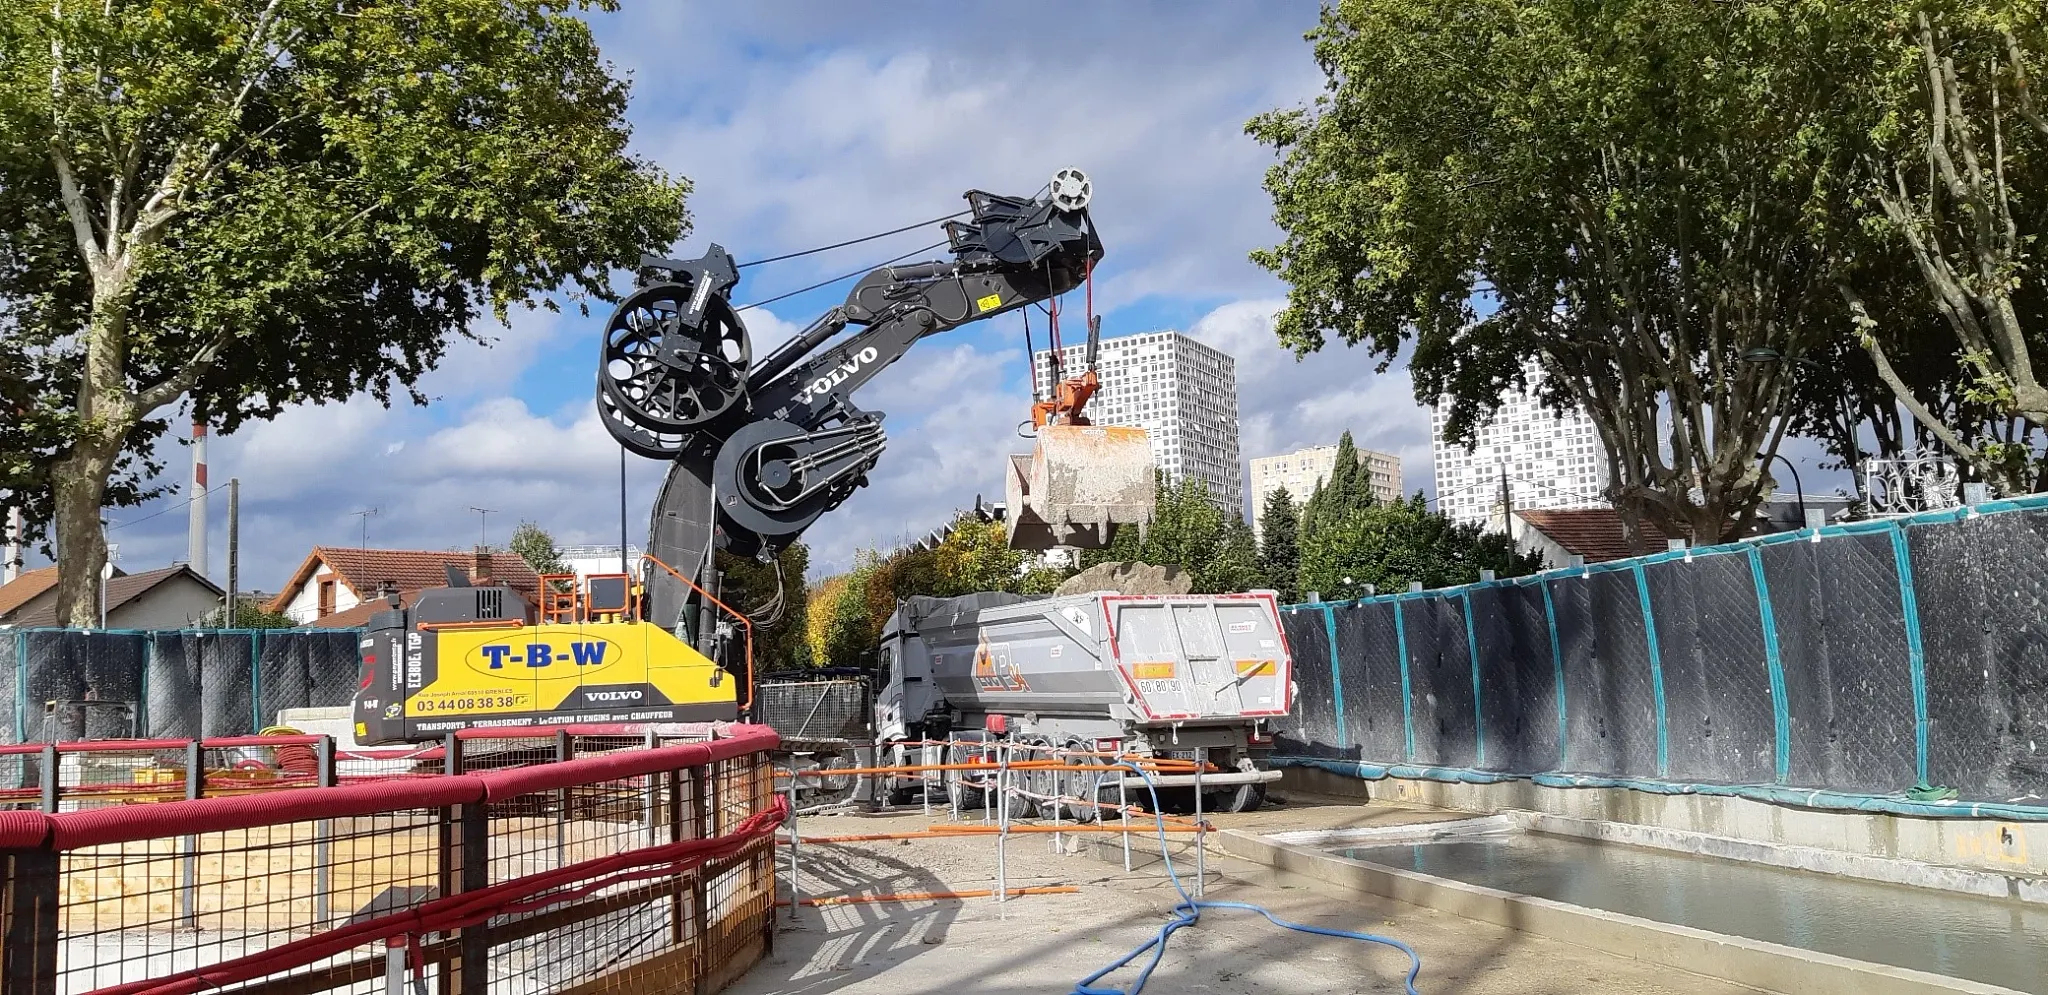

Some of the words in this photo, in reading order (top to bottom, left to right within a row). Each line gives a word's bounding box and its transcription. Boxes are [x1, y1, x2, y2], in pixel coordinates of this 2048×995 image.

[790, 346, 878, 405] VOLVO
[407, 632, 422, 651] TGP
[482, 641, 607, 669] T-B-W
[585, 690, 642, 702] VOLVO
[1140, 681, 1152, 693] 60
[1155, 680, 1167, 692] 80
[1170, 680, 1182, 692] 90
[417, 700, 434, 711] 03
[438, 699, 455, 710] 44
[457, 698, 474, 709] 08
[477, 697, 494, 708] 38
[496, 696, 513, 707] 38
[416, 721, 466, 731] TRANSPORTS
[472, 717, 532, 728] TERRASSEMENT
[576, 713, 610, 723] D'ENGINS
[630, 711, 673, 720] CHAUFFEUR
